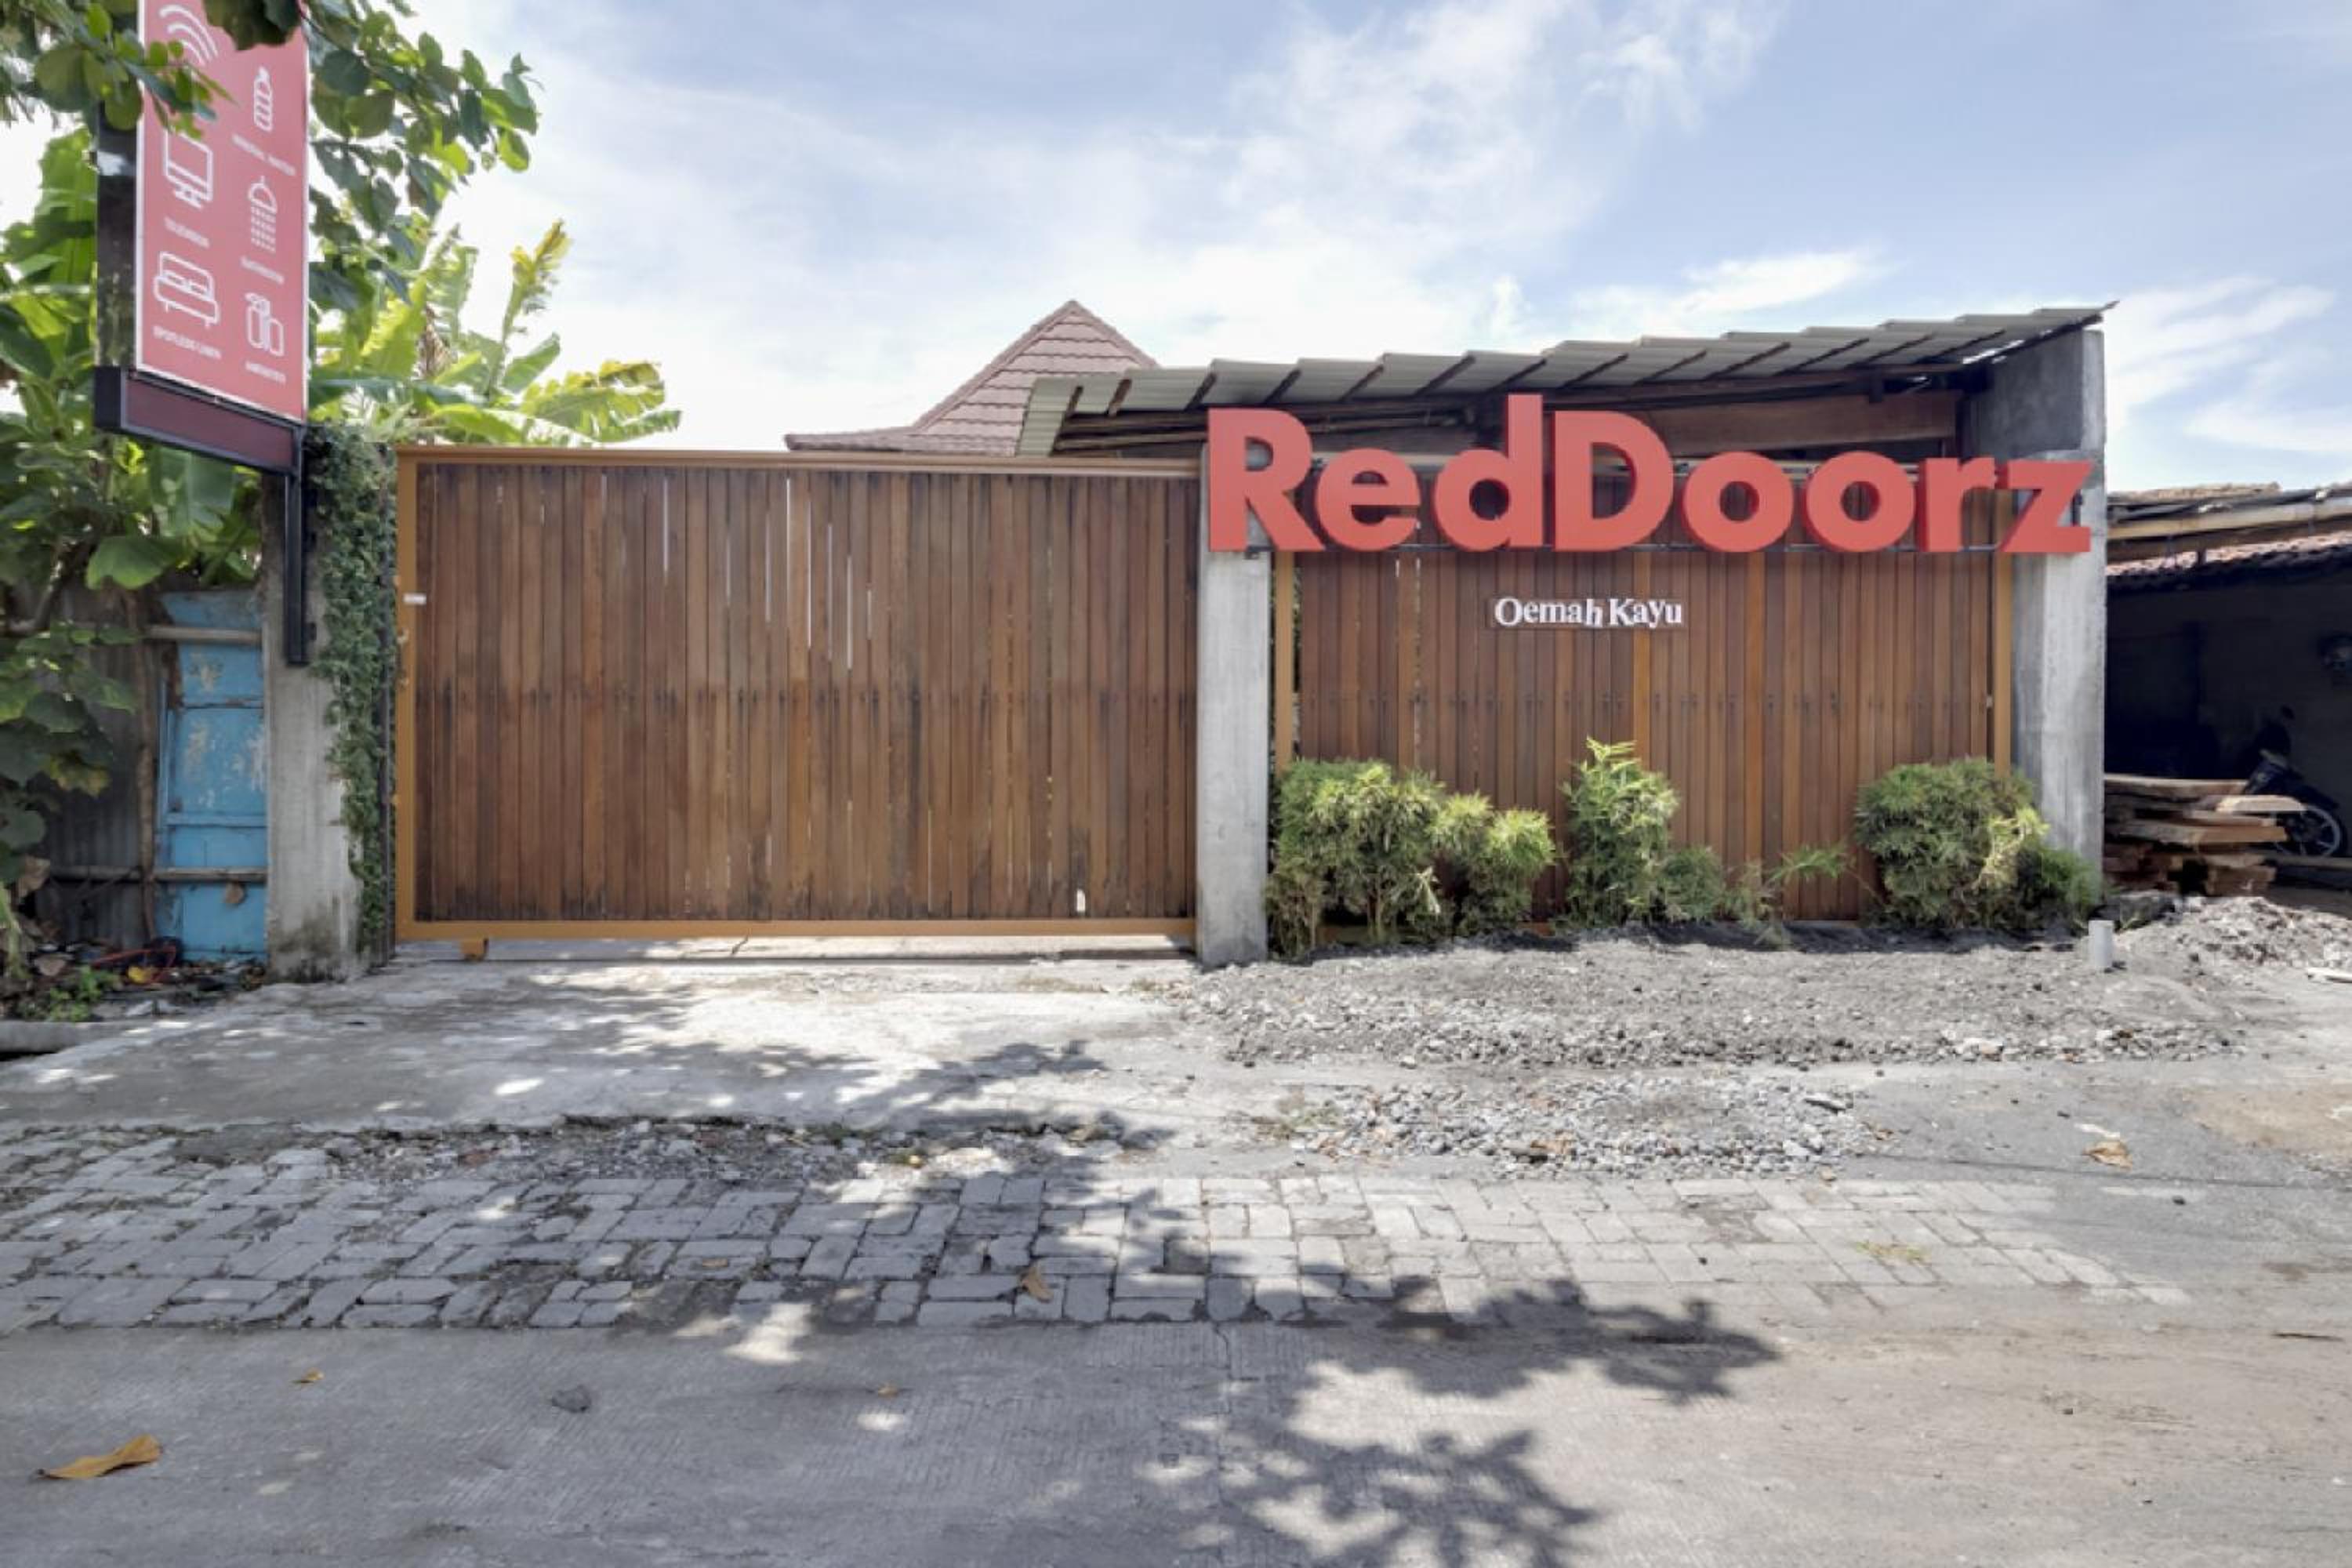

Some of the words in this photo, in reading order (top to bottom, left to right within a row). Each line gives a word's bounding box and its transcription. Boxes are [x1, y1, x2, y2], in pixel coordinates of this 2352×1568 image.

[1208, 394, 2092, 552] RedDoorz
[1494, 597, 1602, 627] Oemah
[1609, 597, 1682, 627] Kayu
